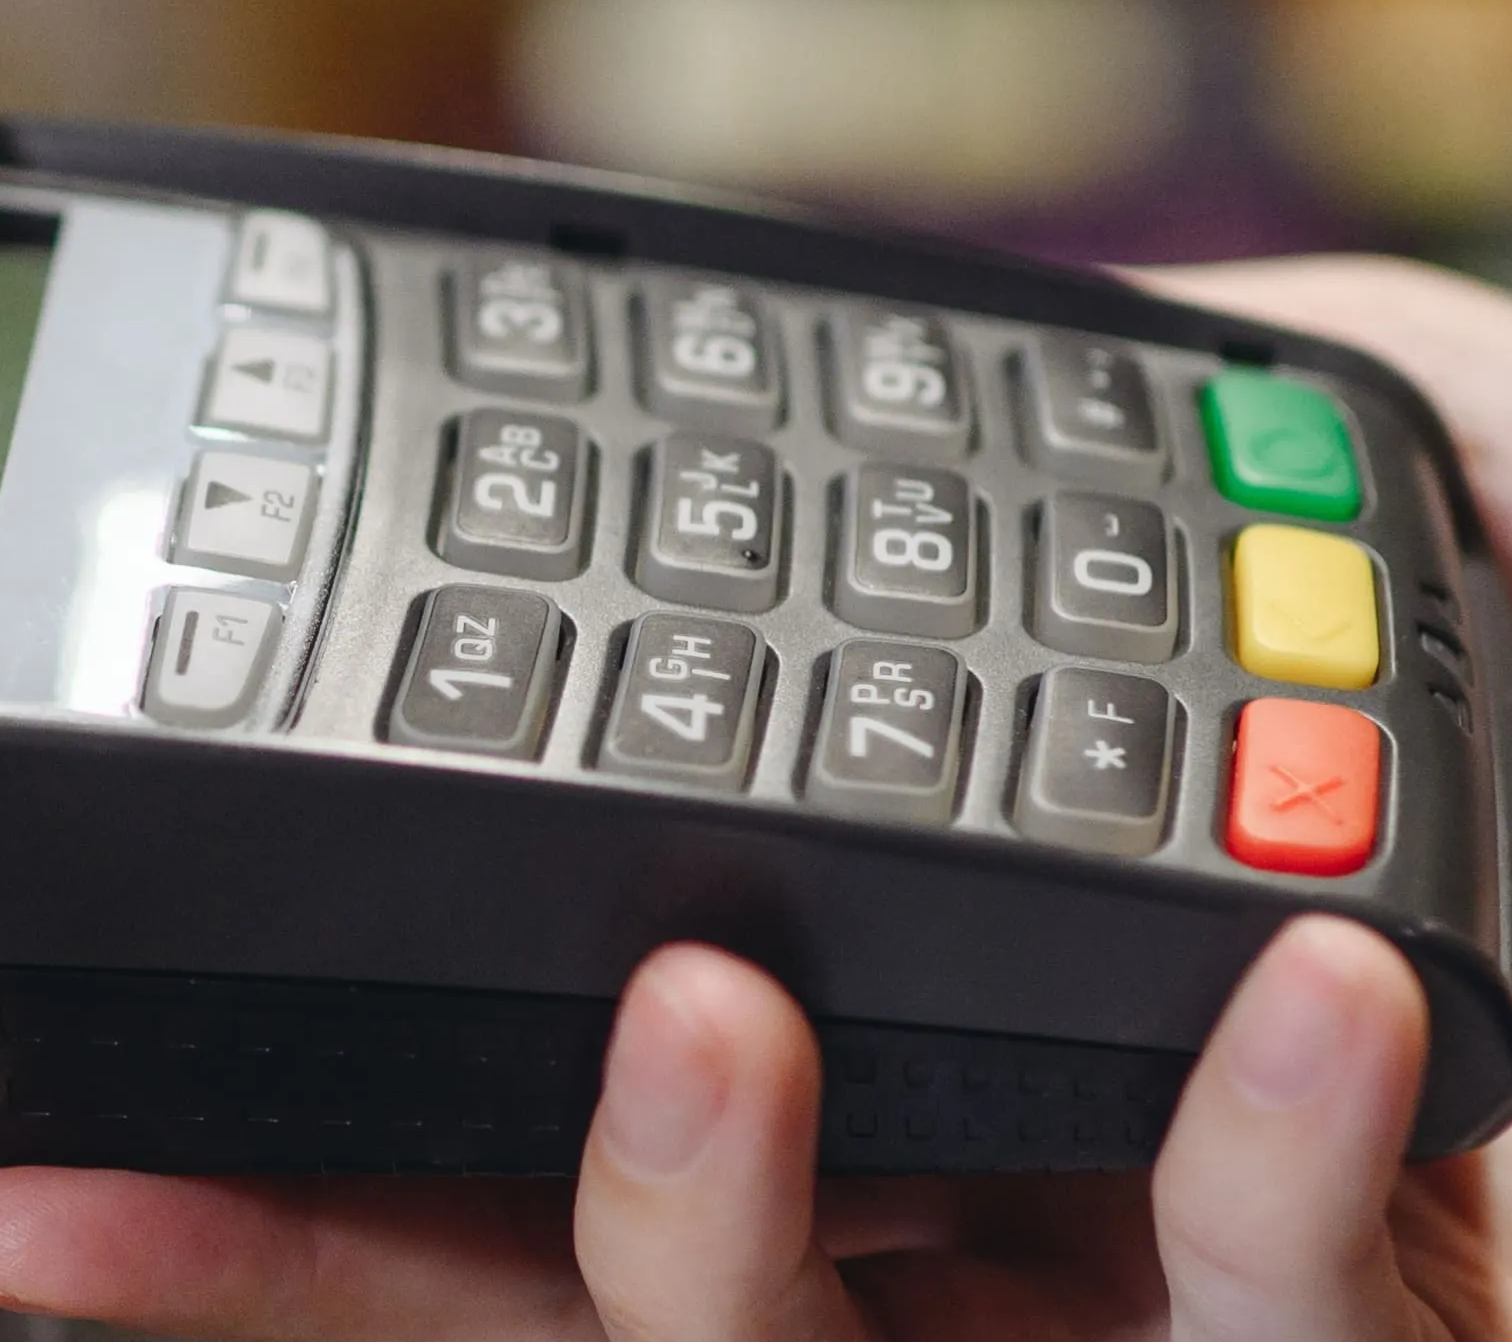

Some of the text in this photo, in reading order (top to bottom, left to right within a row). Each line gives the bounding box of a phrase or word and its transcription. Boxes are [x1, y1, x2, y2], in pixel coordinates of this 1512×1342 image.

[479, 298, 563, 343] 3
[674, 332, 757, 377] 6
[863, 361, 947, 407] 9
[260, 490, 295, 523] F2
[1073, 549, 1153, 596] 0
[211, 614, 249, 647] F1
